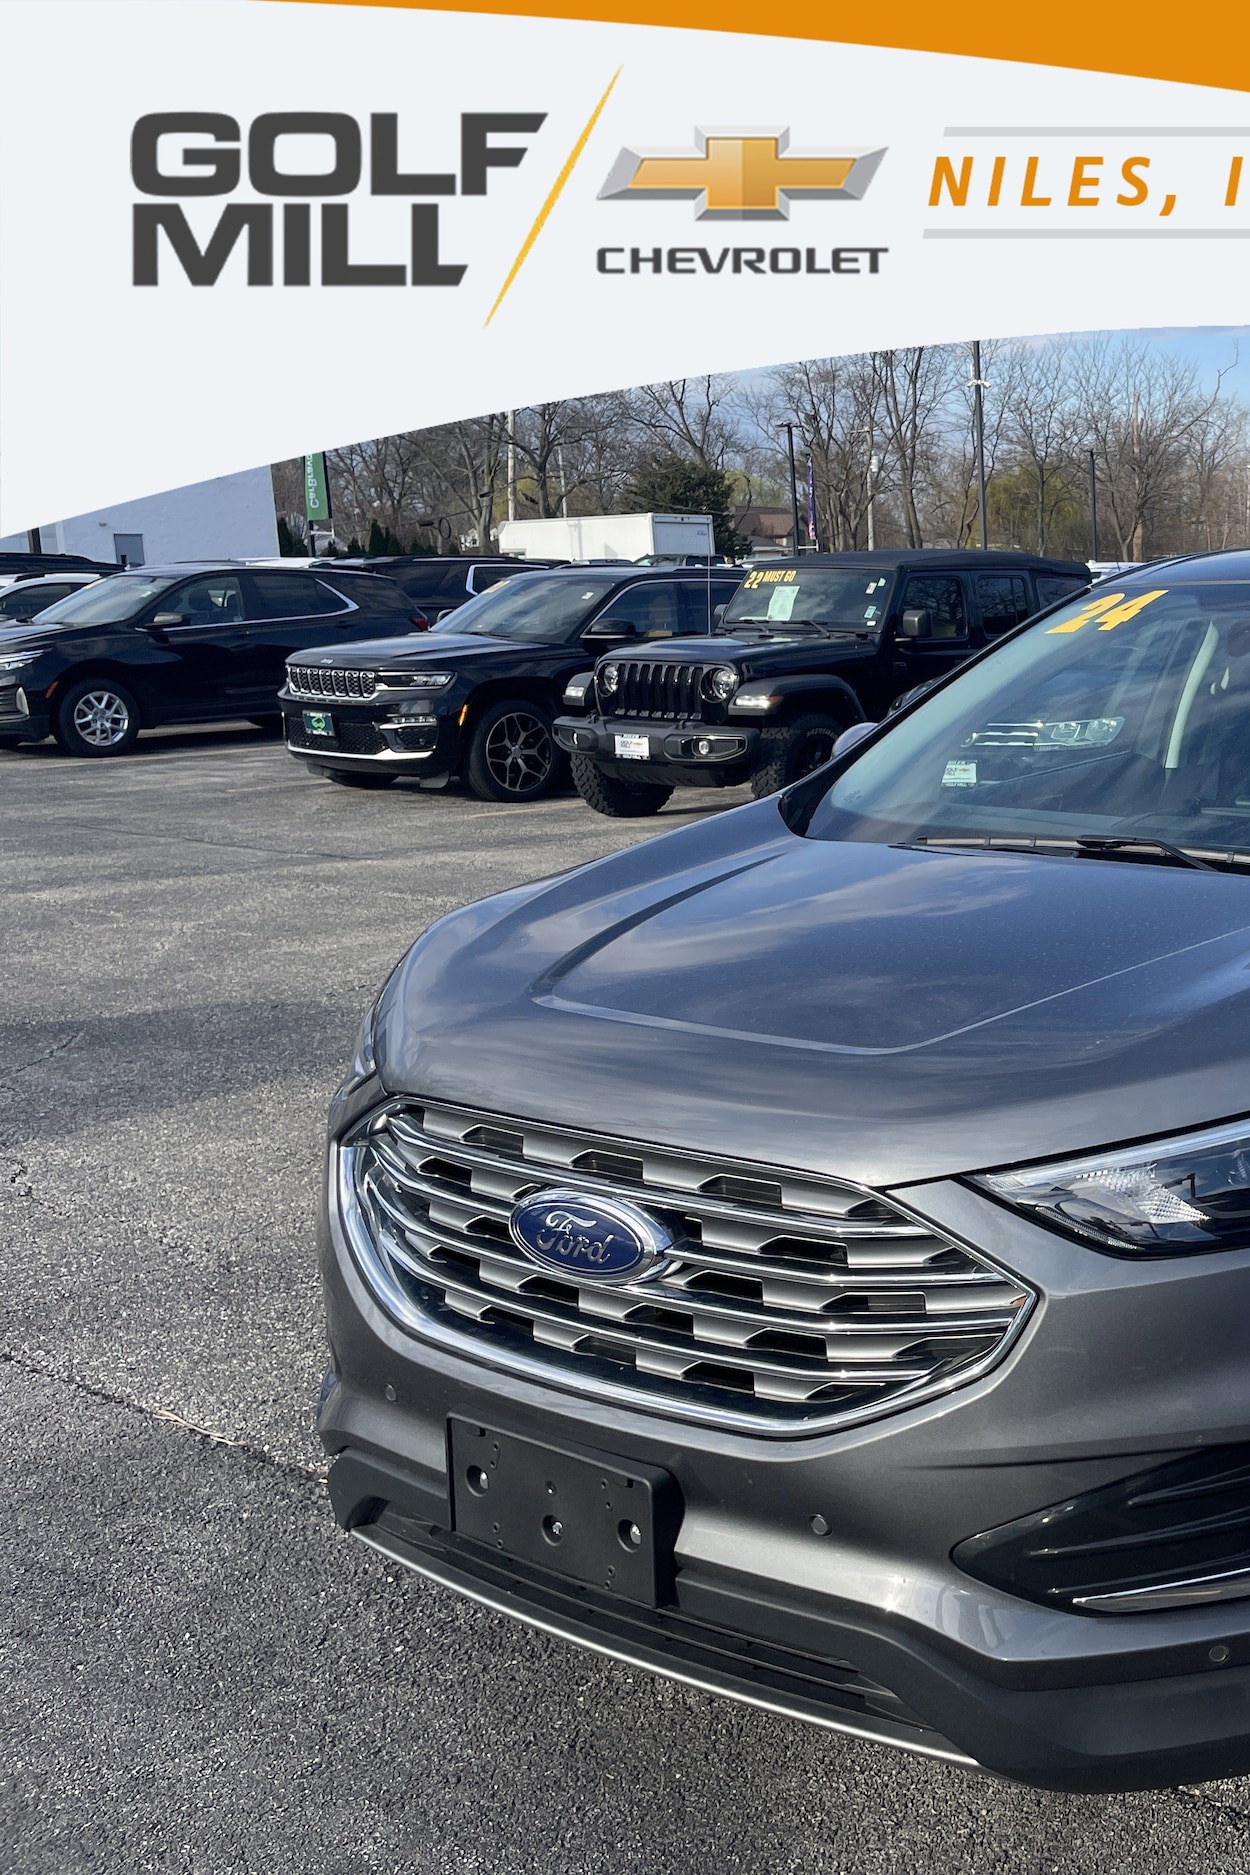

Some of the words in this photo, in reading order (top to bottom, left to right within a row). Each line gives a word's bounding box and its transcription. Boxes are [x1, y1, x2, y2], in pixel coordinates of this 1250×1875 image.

[744, 571, 764, 589] 22
[762, 570, 783, 582] MUST
[783, 570, 797, 582] GO
[1044, 589, 1170, 634] 24
[536, 1210, 615, 1264] Ford
